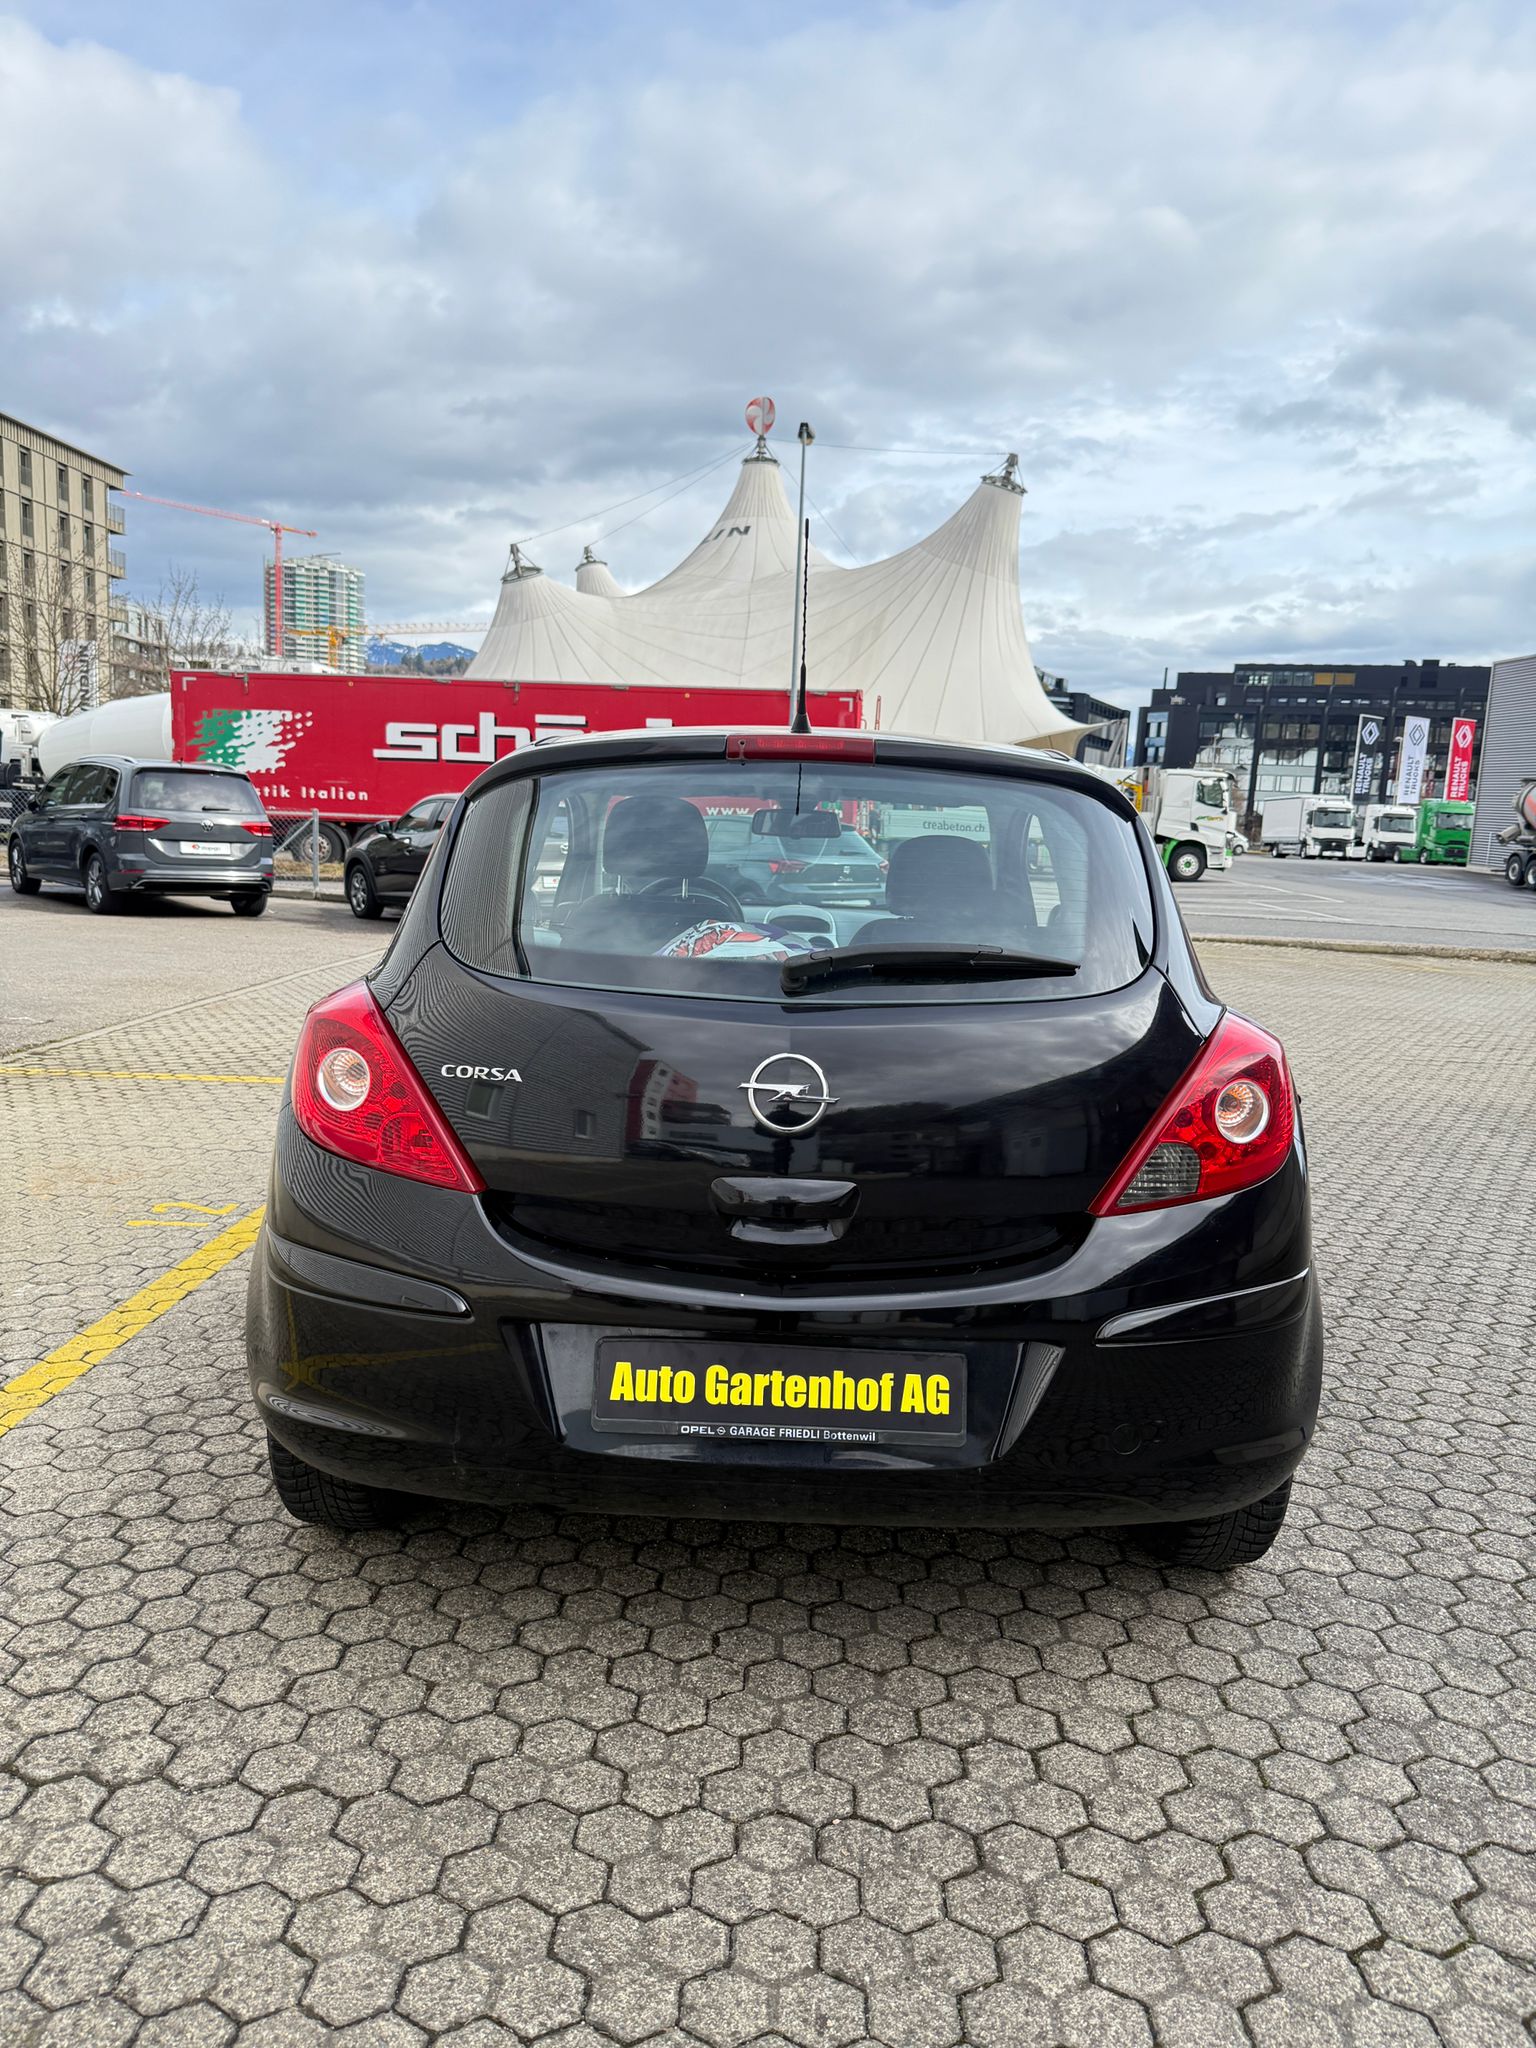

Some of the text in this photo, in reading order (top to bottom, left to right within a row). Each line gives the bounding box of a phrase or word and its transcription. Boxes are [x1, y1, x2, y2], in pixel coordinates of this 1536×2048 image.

[1355, 752, 1367, 794] RENAULT
[1361, 757, 1374, 794] TRUCKS
[1404, 756, 1414, 795] RENAULT
[1410, 760, 1421, 795] TRUCKS
[1450, 756, 1463, 798] RENAULT
[1457, 761, 1469, 797] TRUCKS
[301, 786, 369, 800] Italien
[922, 819, 985, 833] creabeton.ch
[441, 1064, 523, 1082] CORSA
[609, 1361, 950, 1415] Auto Gartenhof AG
[680, 1425, 876, 1442] OPEL GARAGE FRIEDLI Bottenwil
